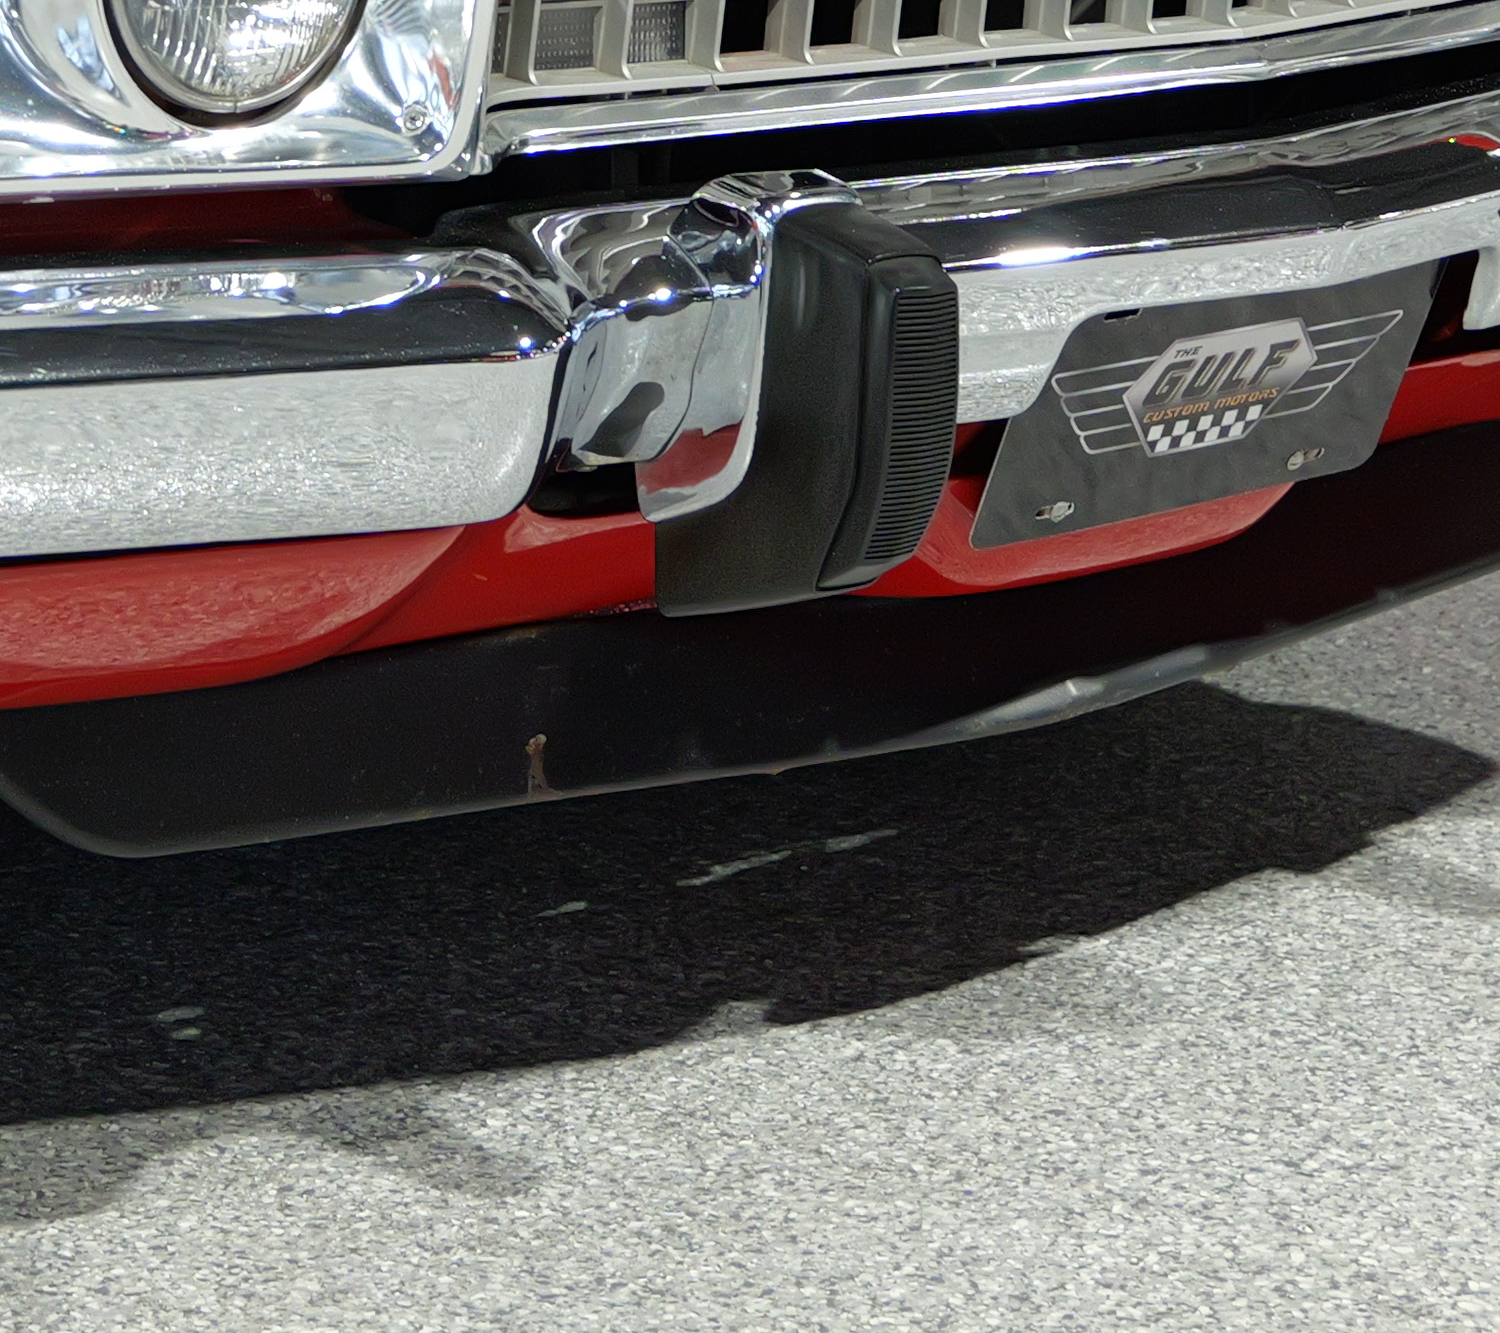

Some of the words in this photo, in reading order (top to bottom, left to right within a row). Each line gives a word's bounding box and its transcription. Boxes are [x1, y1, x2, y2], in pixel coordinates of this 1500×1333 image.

[1173, 345, 1203, 360] THE
[1142, 339, 1301, 407] GULF
[1142, 401, 1210, 424] CUSTOM
[1213, 386, 1281, 410] MOTORS
